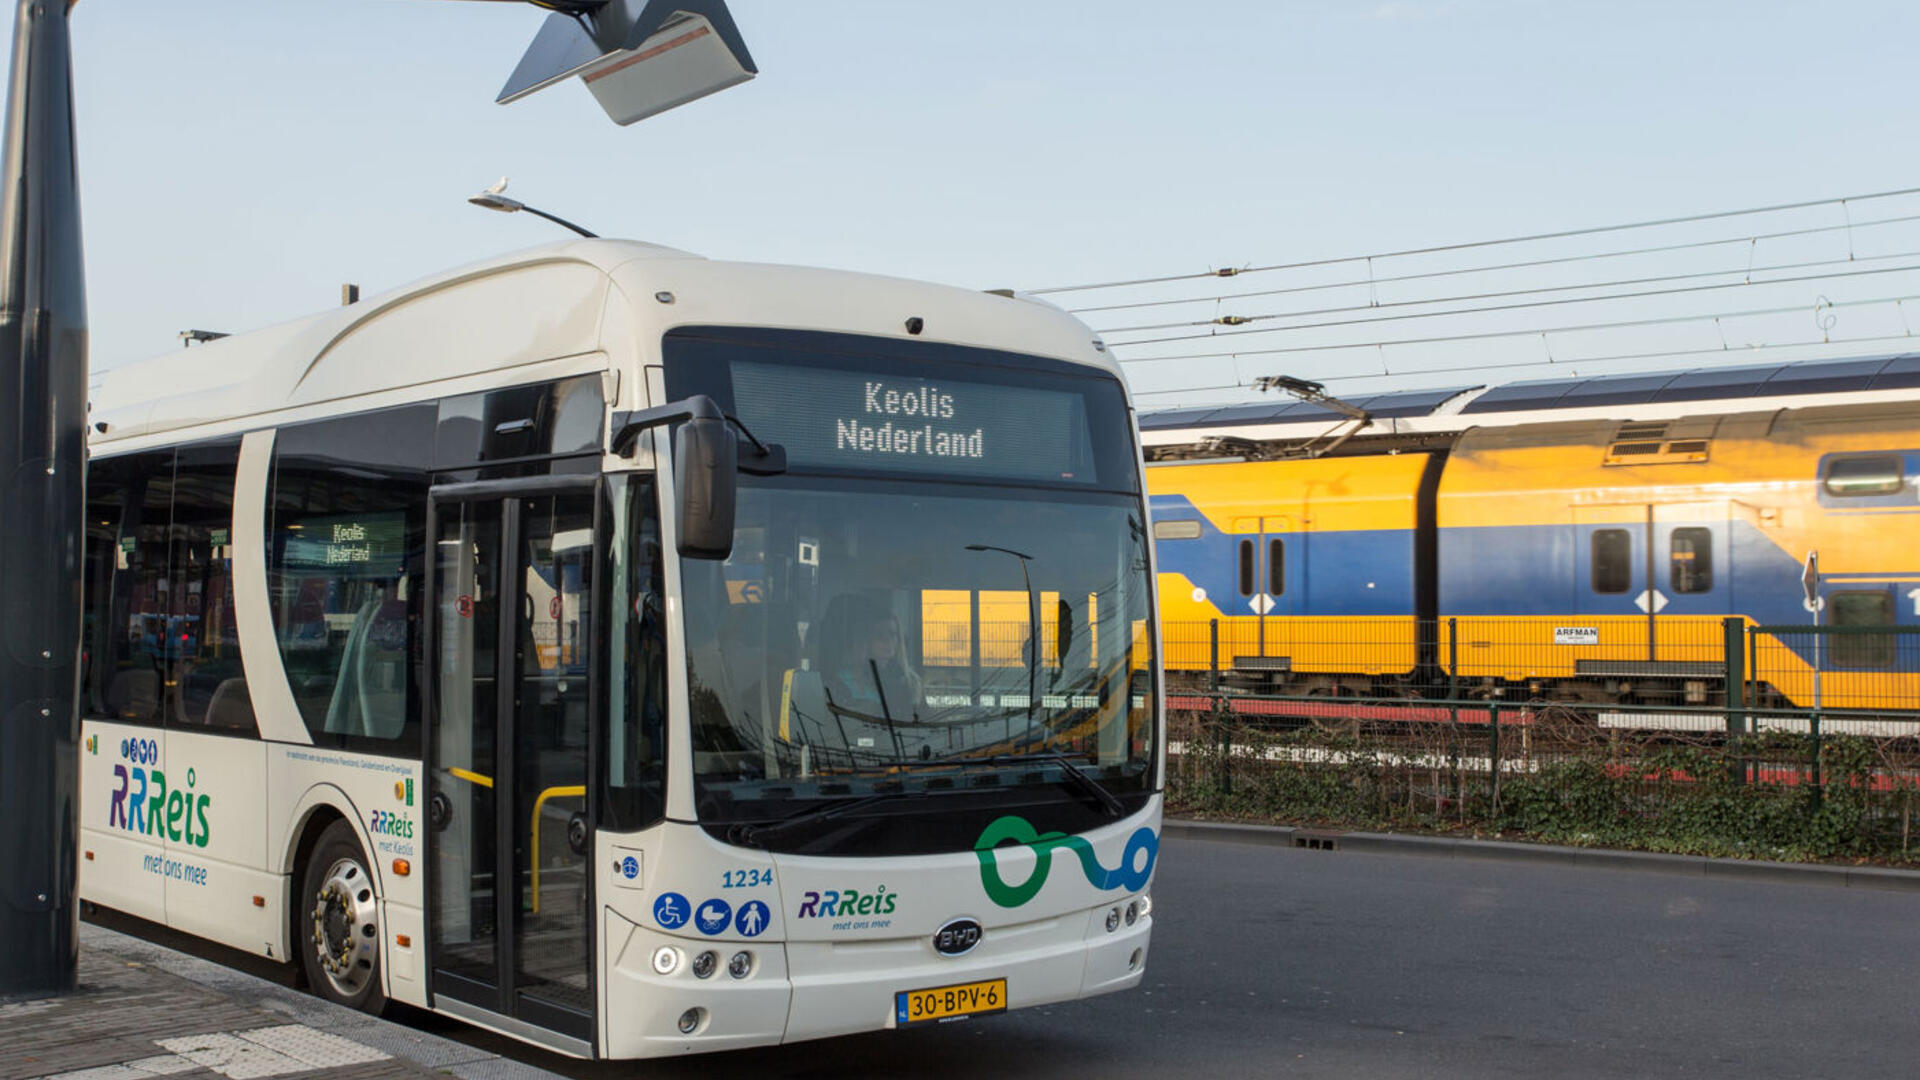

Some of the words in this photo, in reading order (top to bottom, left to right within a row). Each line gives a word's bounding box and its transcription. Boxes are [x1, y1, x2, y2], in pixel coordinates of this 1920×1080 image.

[865, 382, 954, 418] Keolis
[838, 419, 983, 457] Nederland
[1556, 628, 1597, 636] ARFMAN
[109, 764, 211, 848] RRReis
[371, 810, 413, 839] RRReis
[144, 855, 163, 874] met
[164, 859, 182, 880] ons
[184, 864, 207, 886] mee
[722, 868, 773, 889] 1234
[798, 885, 897, 919] RRReis
[832, 921, 852, 930] met
[941, 927, 978, 947] BYD
[912, 985, 998, 1016] 30-BPV-6
